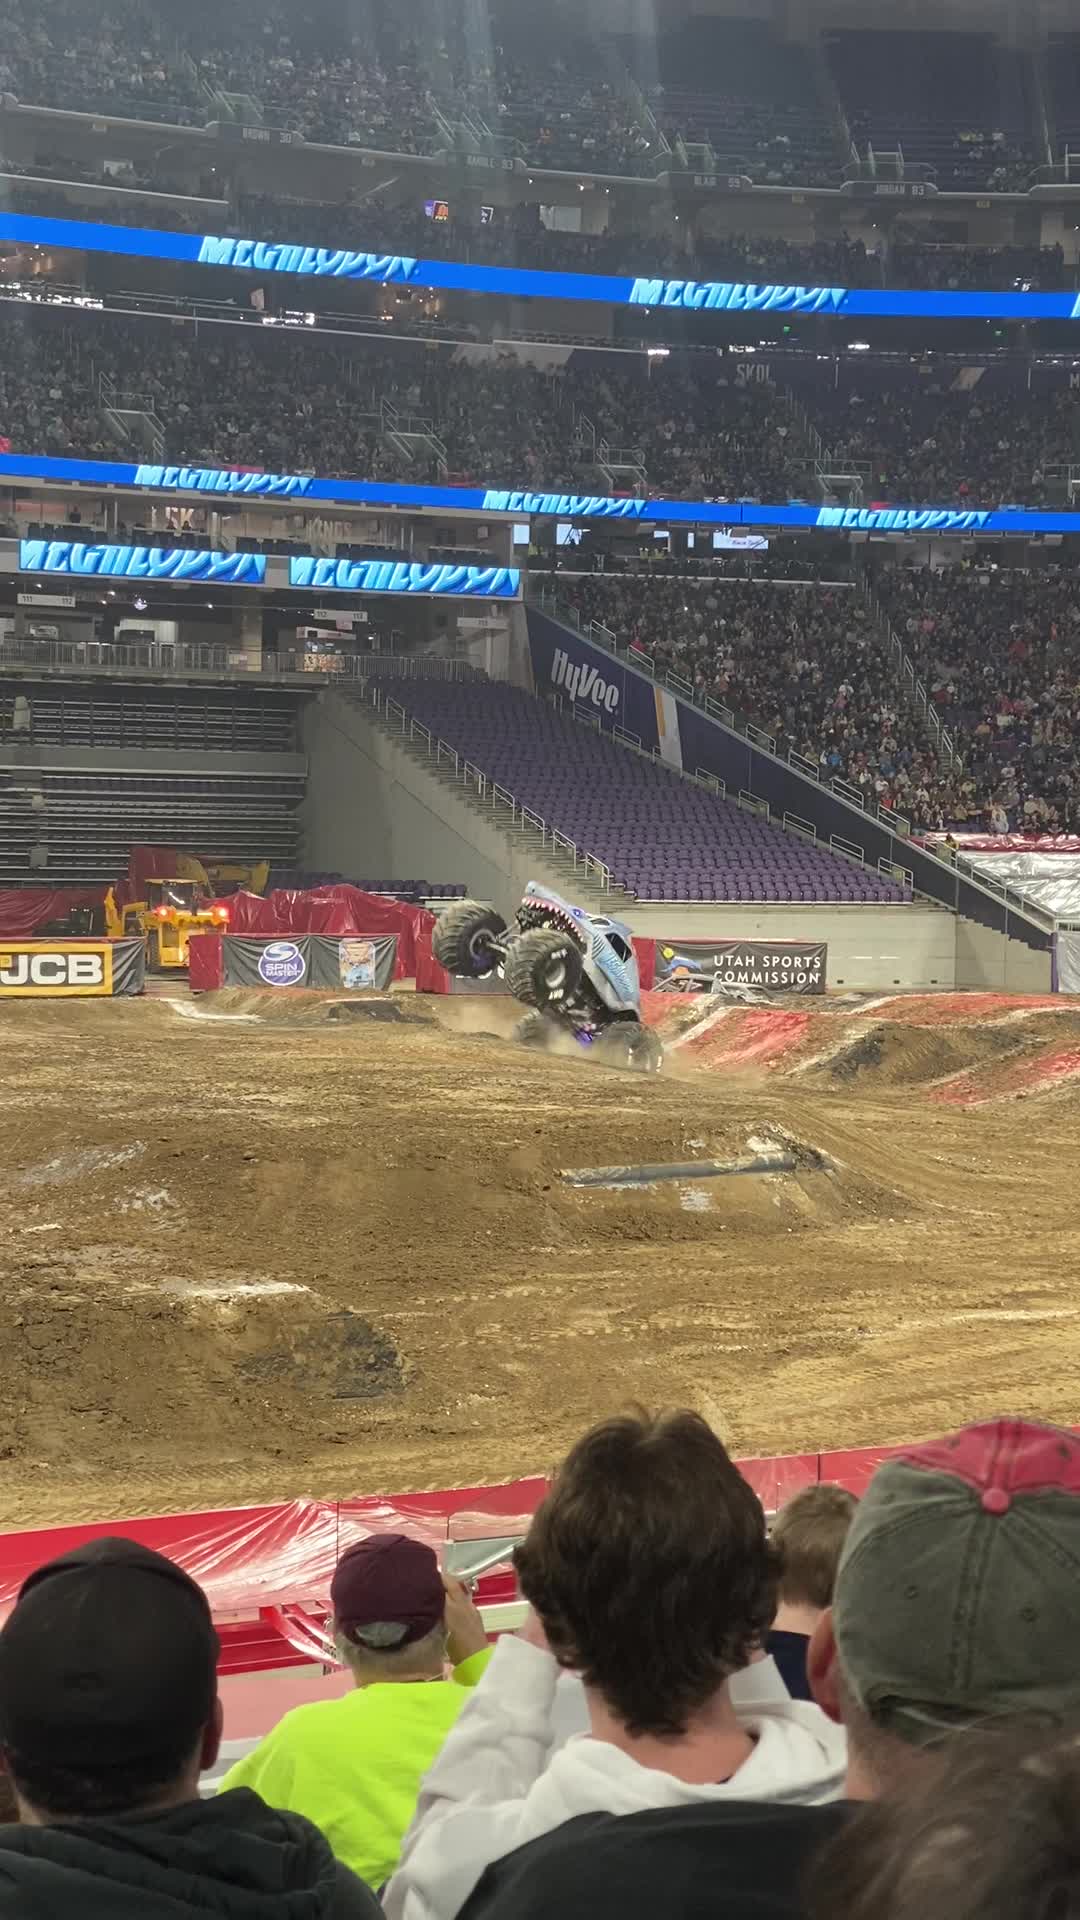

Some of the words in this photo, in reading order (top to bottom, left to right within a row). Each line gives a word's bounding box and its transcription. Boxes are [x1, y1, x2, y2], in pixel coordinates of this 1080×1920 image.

[264, 963, 298, 971] SPIN
[713, 955, 755, 967] UTAH
[762, 955, 821, 969] SPORTS
[0, 954, 103, 985] JCB
[713, 970, 819, 984] COMMISSION
